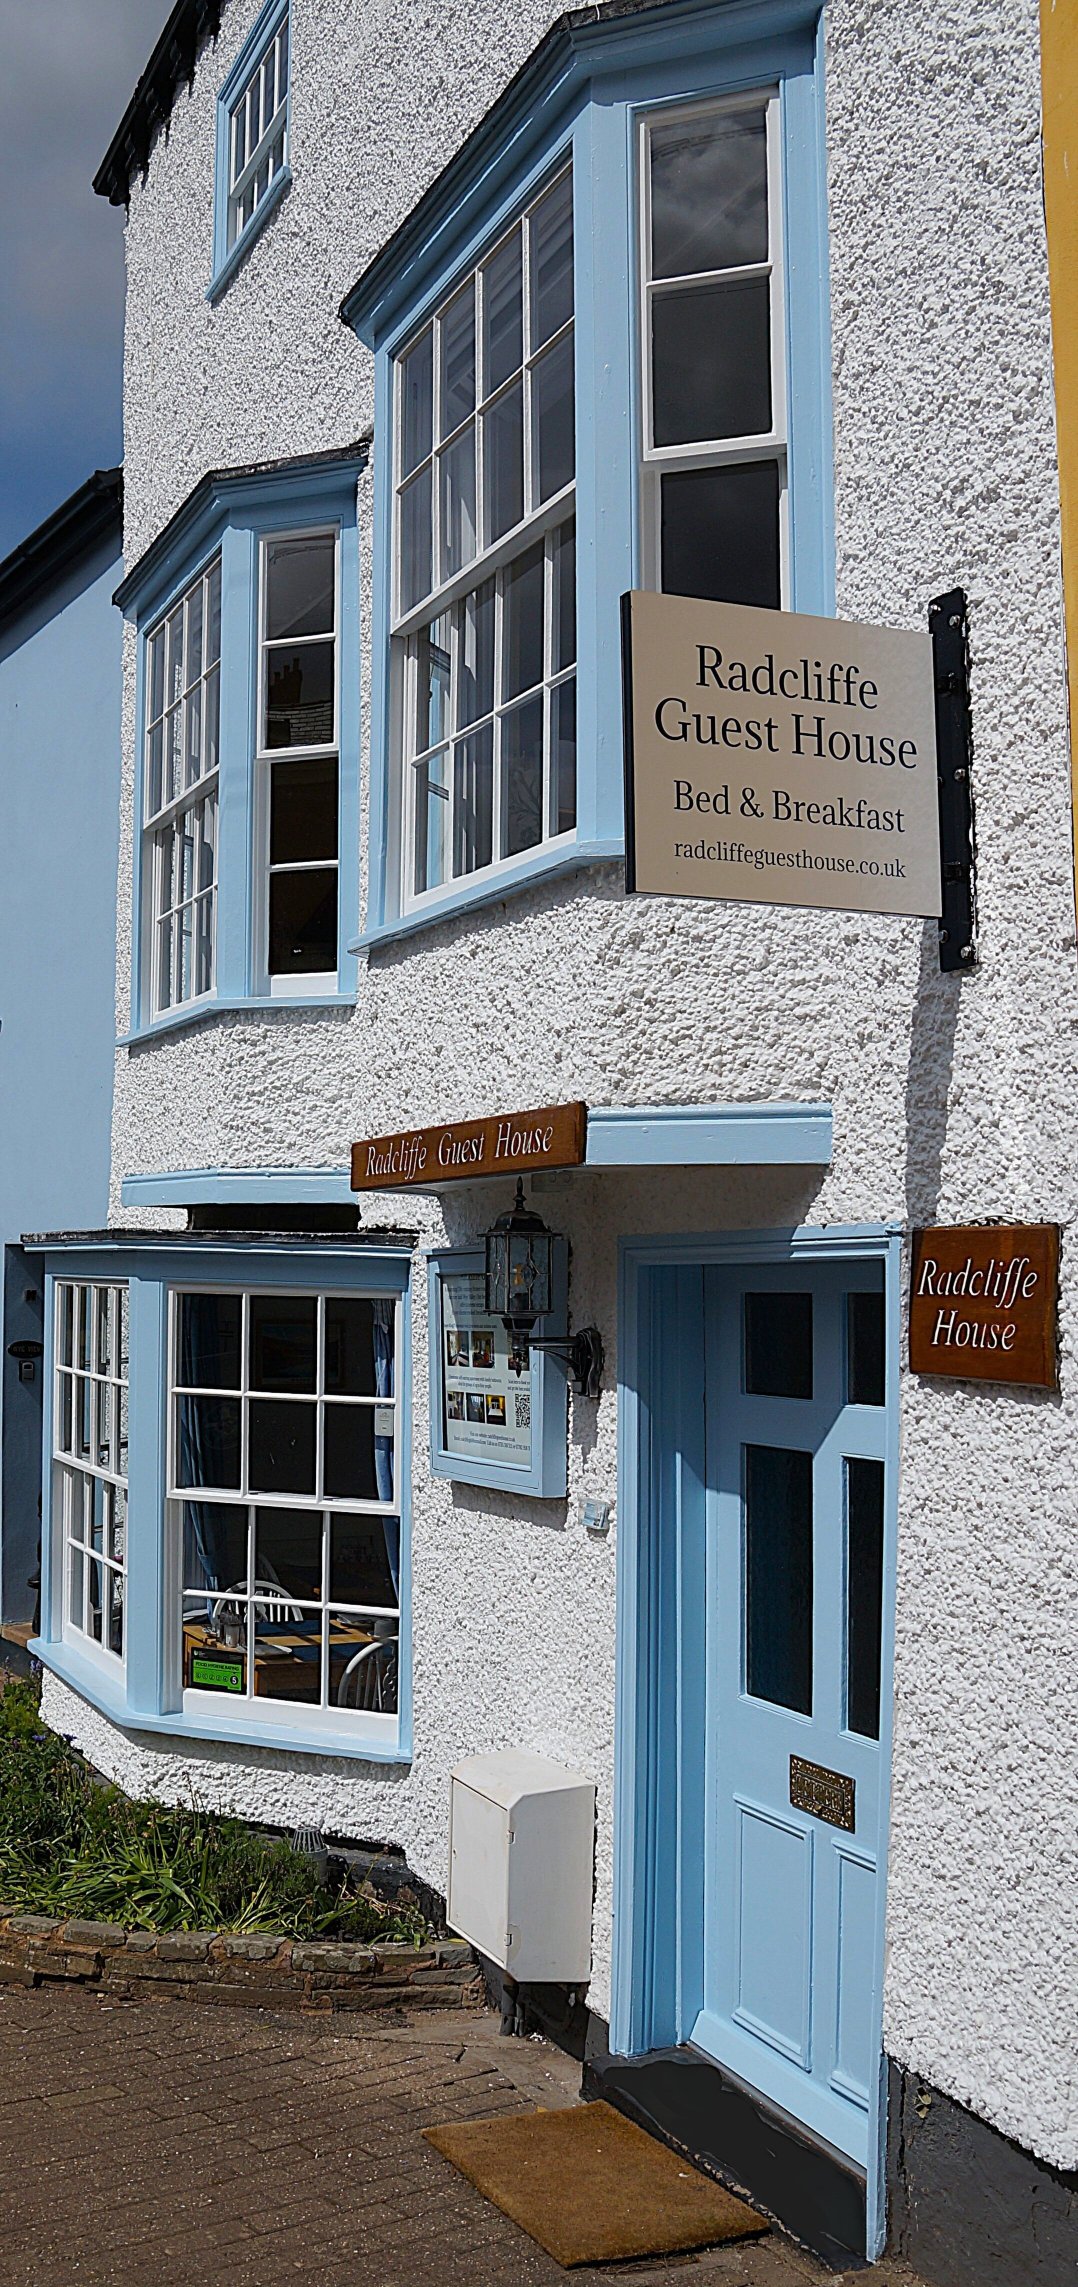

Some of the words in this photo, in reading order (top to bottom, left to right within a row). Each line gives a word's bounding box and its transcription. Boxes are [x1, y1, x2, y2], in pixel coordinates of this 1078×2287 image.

[696, 645, 877, 709] Radcliffe
[655, 698, 779, 752] Guest
[791, 714, 916, 768] House
[674, 780, 731, 814] Bed
[740, 788, 764, 818] &
[772, 791, 905, 832] Breakfast
[675, 840, 906, 877] radcliffeguesthouse.co.uk
[366, 1136, 426, 1179] Radcliffe
[439, 1133, 484, 1165] Guest
[495, 1123, 552, 1157] House
[918, 1258, 1037, 1308] Radcliffe
[932, 1310, 1015, 1349] House
[231, 1676, 237, 1684] 5
